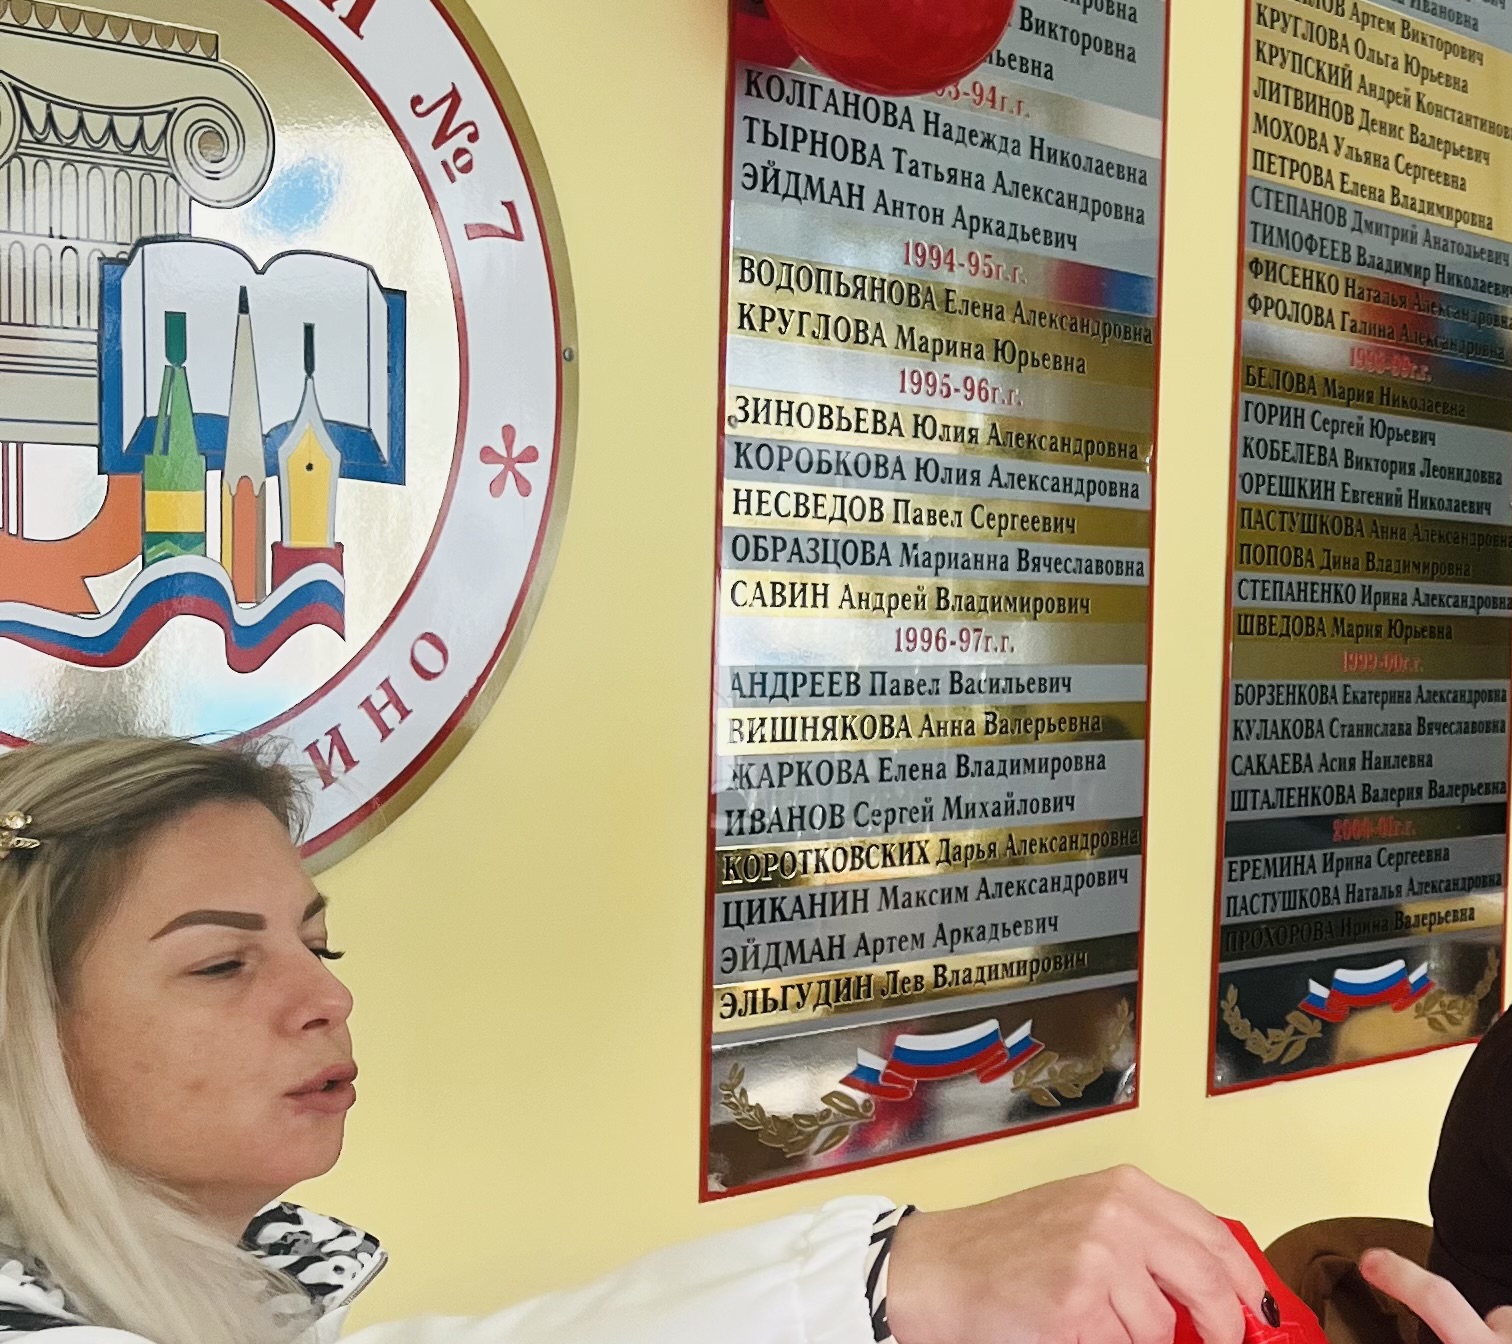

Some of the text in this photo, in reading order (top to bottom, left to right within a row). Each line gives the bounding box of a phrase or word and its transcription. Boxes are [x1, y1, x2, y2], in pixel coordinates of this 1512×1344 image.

[1018, 4, 1137, 64] Викторовна
[1255, 2, 1469, 94] КРУГЛОВА Ольга Юрьевна
[1349, 0, 1396, 36] Артем
[1399, 17, 1484, 67] Викторович
[1253, 38, 1353, 91] КРУПСКИЙ
[1356, 71, 1412, 109] Андрей
[743, 67, 1148, 187] КОЛГАНОВА Надежда Николаевна
[1251, 111, 1467, 192] МОХОВА Ульяна Сергеевна
[1252, 75, 1491, 167] ЛИТВИНОВ Денис Валерьевич
[409, 82, 481, 184] №
[465, 199, 524, 246] 7
[742, 114, 1146, 226] ТЫРНОВА Татьяна Александровна
[1251, 147, 1494, 231] ПЕТРОВА Елена Владимировна
[740, 159, 1078, 252] ЭЙДМАН Антон Аркадьевич
[1249, 183, 1510, 268] СТЕПАНОВ Дмитрий Анатольевич
[902, 238, 1027, 285] 1994-95г.г.
[1248, 219, 1353, 264] ТИМОФЕЕВ
[1355, 244, 1431, 286] Владимир
[738, 255, 1153, 345] ВОДОПЬЯНОВА Елена Александровна
[736, 301, 1087, 375] КРУГЛОВА Марина Юрьевна
[897, 366, 1024, 407] 1995-96г.г.
[734, 394, 1139, 462] ЗИНОВЬЕВА Юлия Александровна
[1242, 399, 1436, 446] ГОРИН Сергей Юрьевич
[733, 441, 1140, 502] КОРОБКОВА Юлия Александровна
[1241, 435, 1503, 486] КОБЕЛЕВА Виктория Леонидовна
[732, 487, 1077, 536] НЕСВЕДОВ Павел Сергеевич
[1240, 471, 1492, 516] ОРЕШКИН Евгений Николаевич
[730, 533, 1146, 578] ОБРАЗЦОВА Марианна Вячеславовна
[729, 579, 1091, 620] САВИН Андрей Владимирович
[1236, 577, 1357, 604] СТЕПАНЕНКО
[1360, 583, 1408, 610] Ирина
[893, 626, 1015, 653] 1996-97г.г.
[301, 628, 450, 792] ИНО
[729, 669, 1073, 701] АНДРЕЕВ Павел Васильевич
[727, 710, 1102, 745] ВИШНЯКОВА Анна Валерьевна
[1231, 715, 1506, 742] КУЛАКОВА Станислава Вячеславовна
[728, 752, 1107, 792] ЖАРКОВА Елена Владимировна
[1229, 778, 1507, 813] ШТАЛЕНКОВА Валерия Валерьевна
[723, 791, 1076, 838] ИВАНОВ Сергей Михайлович
[722, 828, 1139, 884] КОРОТКОВСКИХ Дарья Александровна
[1227, 846, 1451, 883] ЕРЕМИНА Ирина Сергеевна
[721, 867, 1129, 934] ЦИКАНИН Максим Александрович
[720, 914, 1059, 976] ЭЙДМАН Артем Аркадьевич
[719, 950, 1088, 1021] ЭЛЬГУДИН Лев Владимирович
